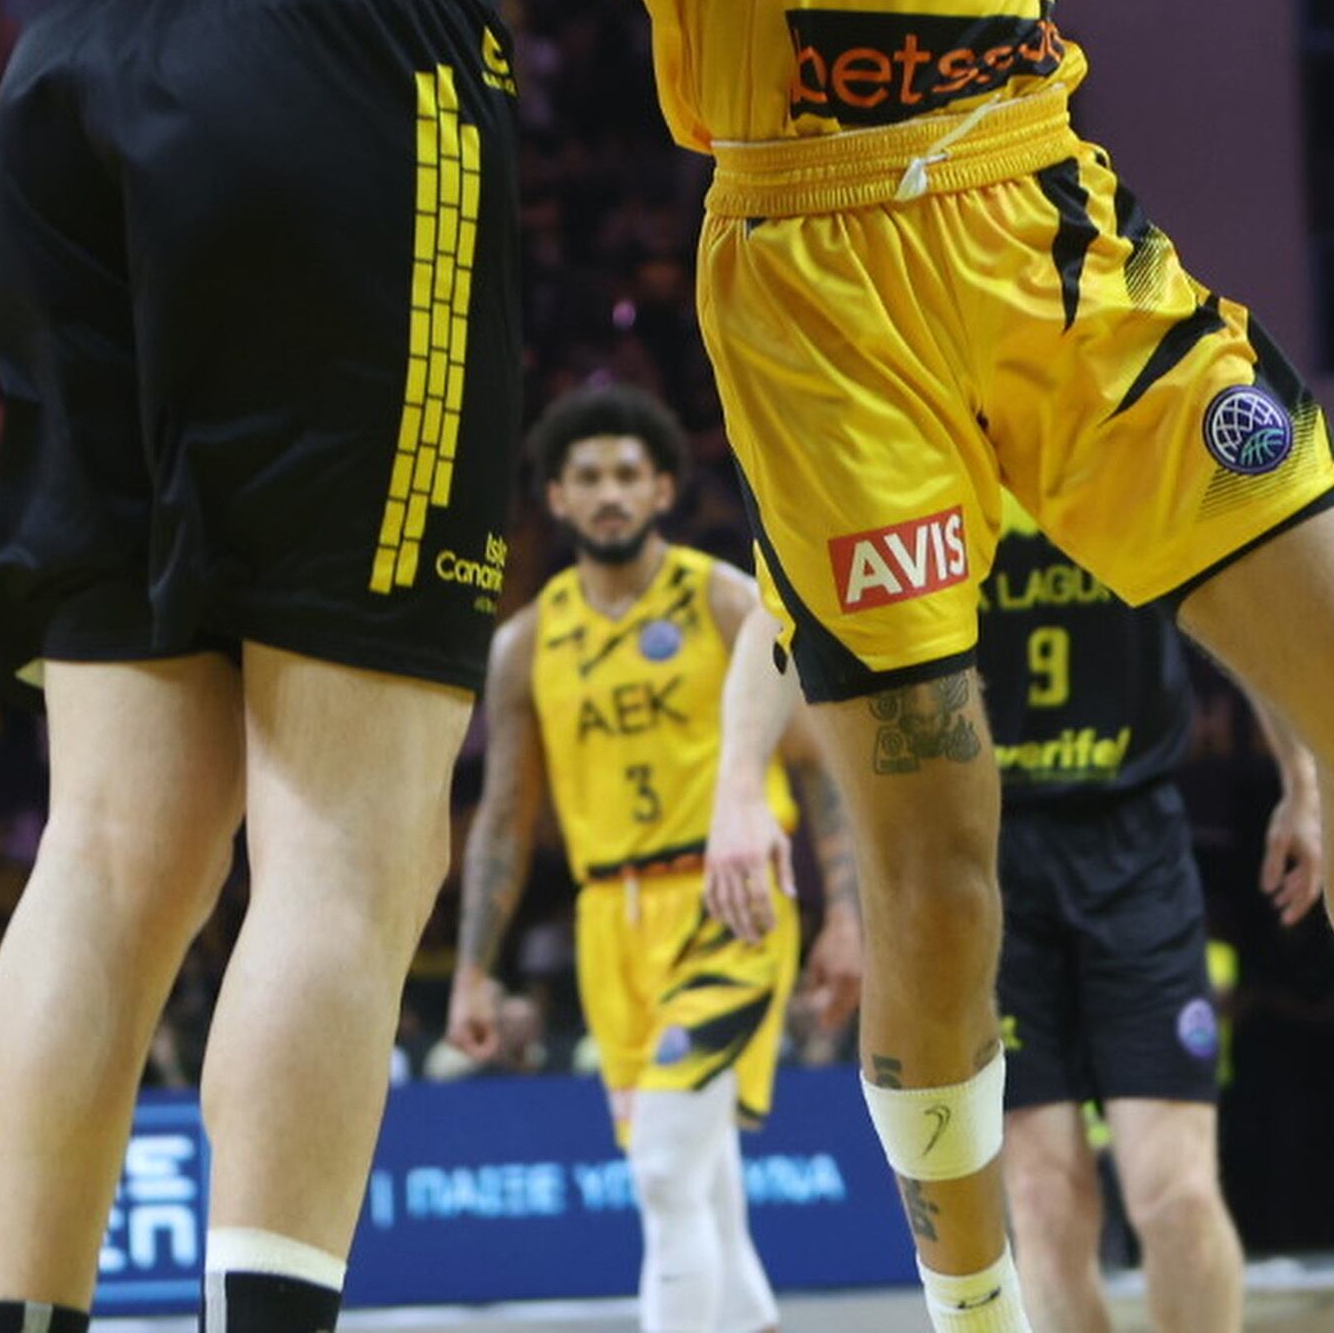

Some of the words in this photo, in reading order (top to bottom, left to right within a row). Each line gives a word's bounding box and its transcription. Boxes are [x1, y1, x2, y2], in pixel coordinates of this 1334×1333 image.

[845, 513, 966, 605] AVIS
[1027, 624, 1072, 708] 9
[577, 675, 691, 745] AEK
[625, 764, 662, 824] 3
